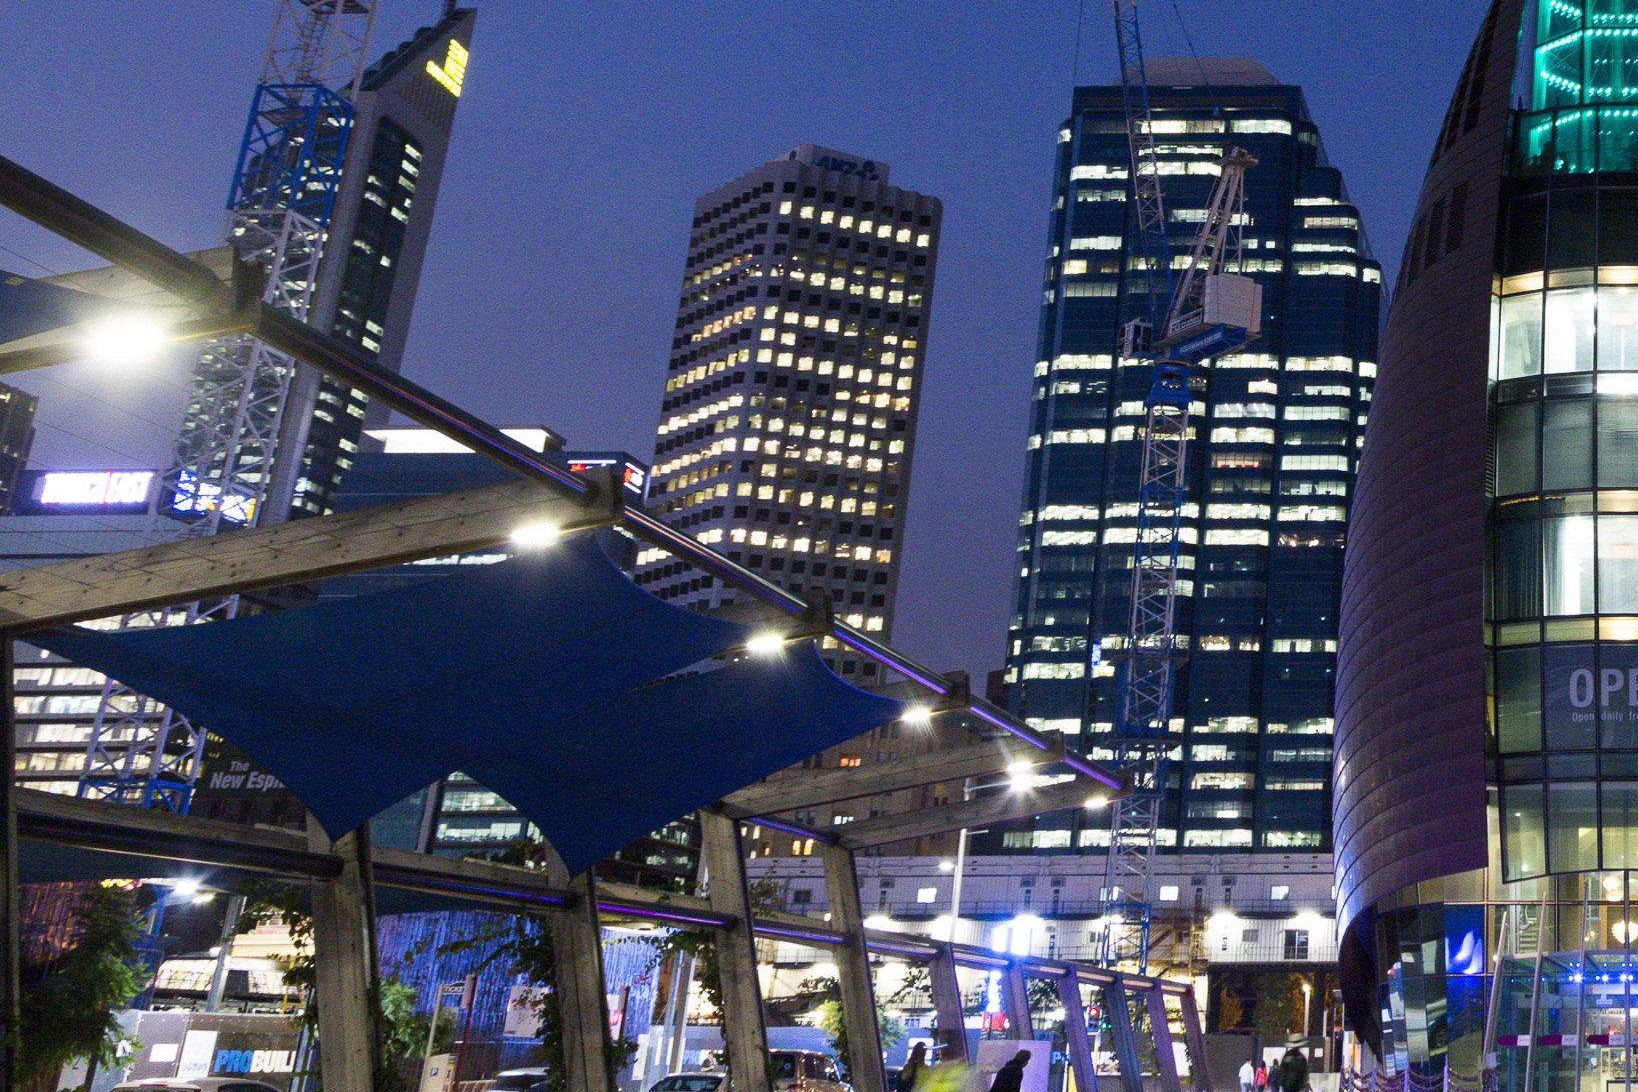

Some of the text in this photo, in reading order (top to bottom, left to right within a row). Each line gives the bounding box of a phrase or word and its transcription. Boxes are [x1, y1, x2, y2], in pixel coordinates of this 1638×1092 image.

[1572, 712, 1595, 722] Open
[1601, 711, 1624, 722] daily
[231, 761, 250, 772] The
[210, 772, 245, 789] New
